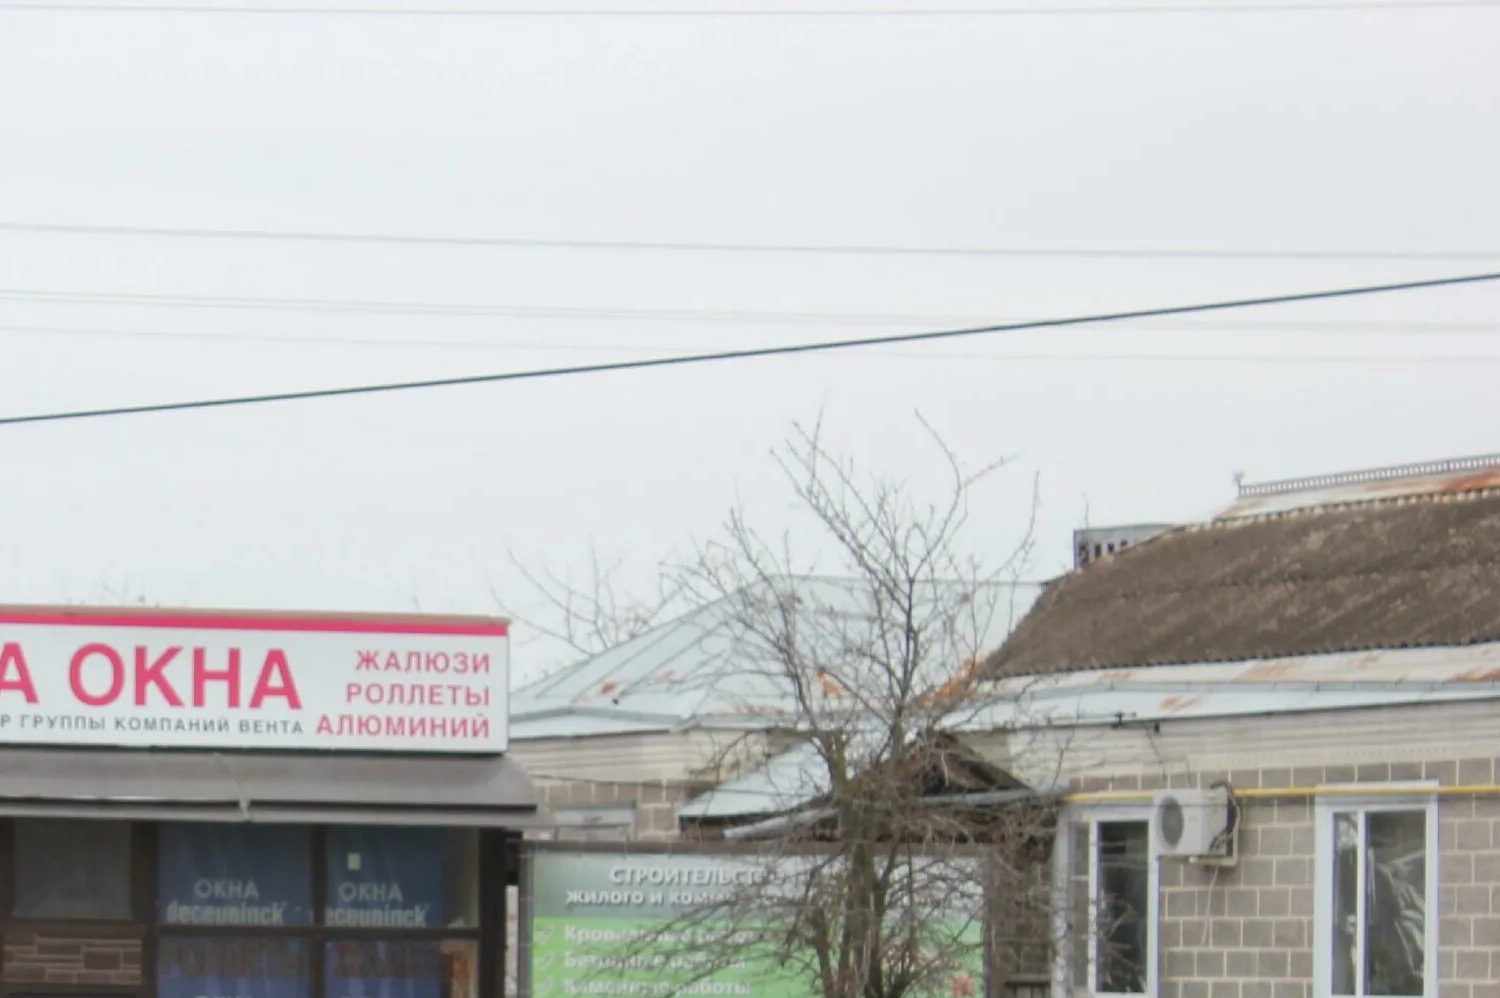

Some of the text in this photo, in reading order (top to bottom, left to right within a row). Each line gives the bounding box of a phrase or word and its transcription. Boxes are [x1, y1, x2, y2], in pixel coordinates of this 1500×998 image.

[356, 650, 490, 674] ЖАЛЮЗИ
[69, 641, 303, 710] ОКНА
[346, 683, 490, 707] РОЛЛЕТЫ
[21, 713, 106, 731] ГРУППЫ
[115, 713, 230, 734] КОМПАНИЙ
[240, 718, 304, 735] ВЕНТА
[316, 712, 491, 739] АЛЮМИНИЙ
[194, 878, 259, 899] ОКНА
[337, 881, 404, 902] ОКНА
[566, 890, 644, 905] жилого
[308, 905, 427, 928] eceuninck
